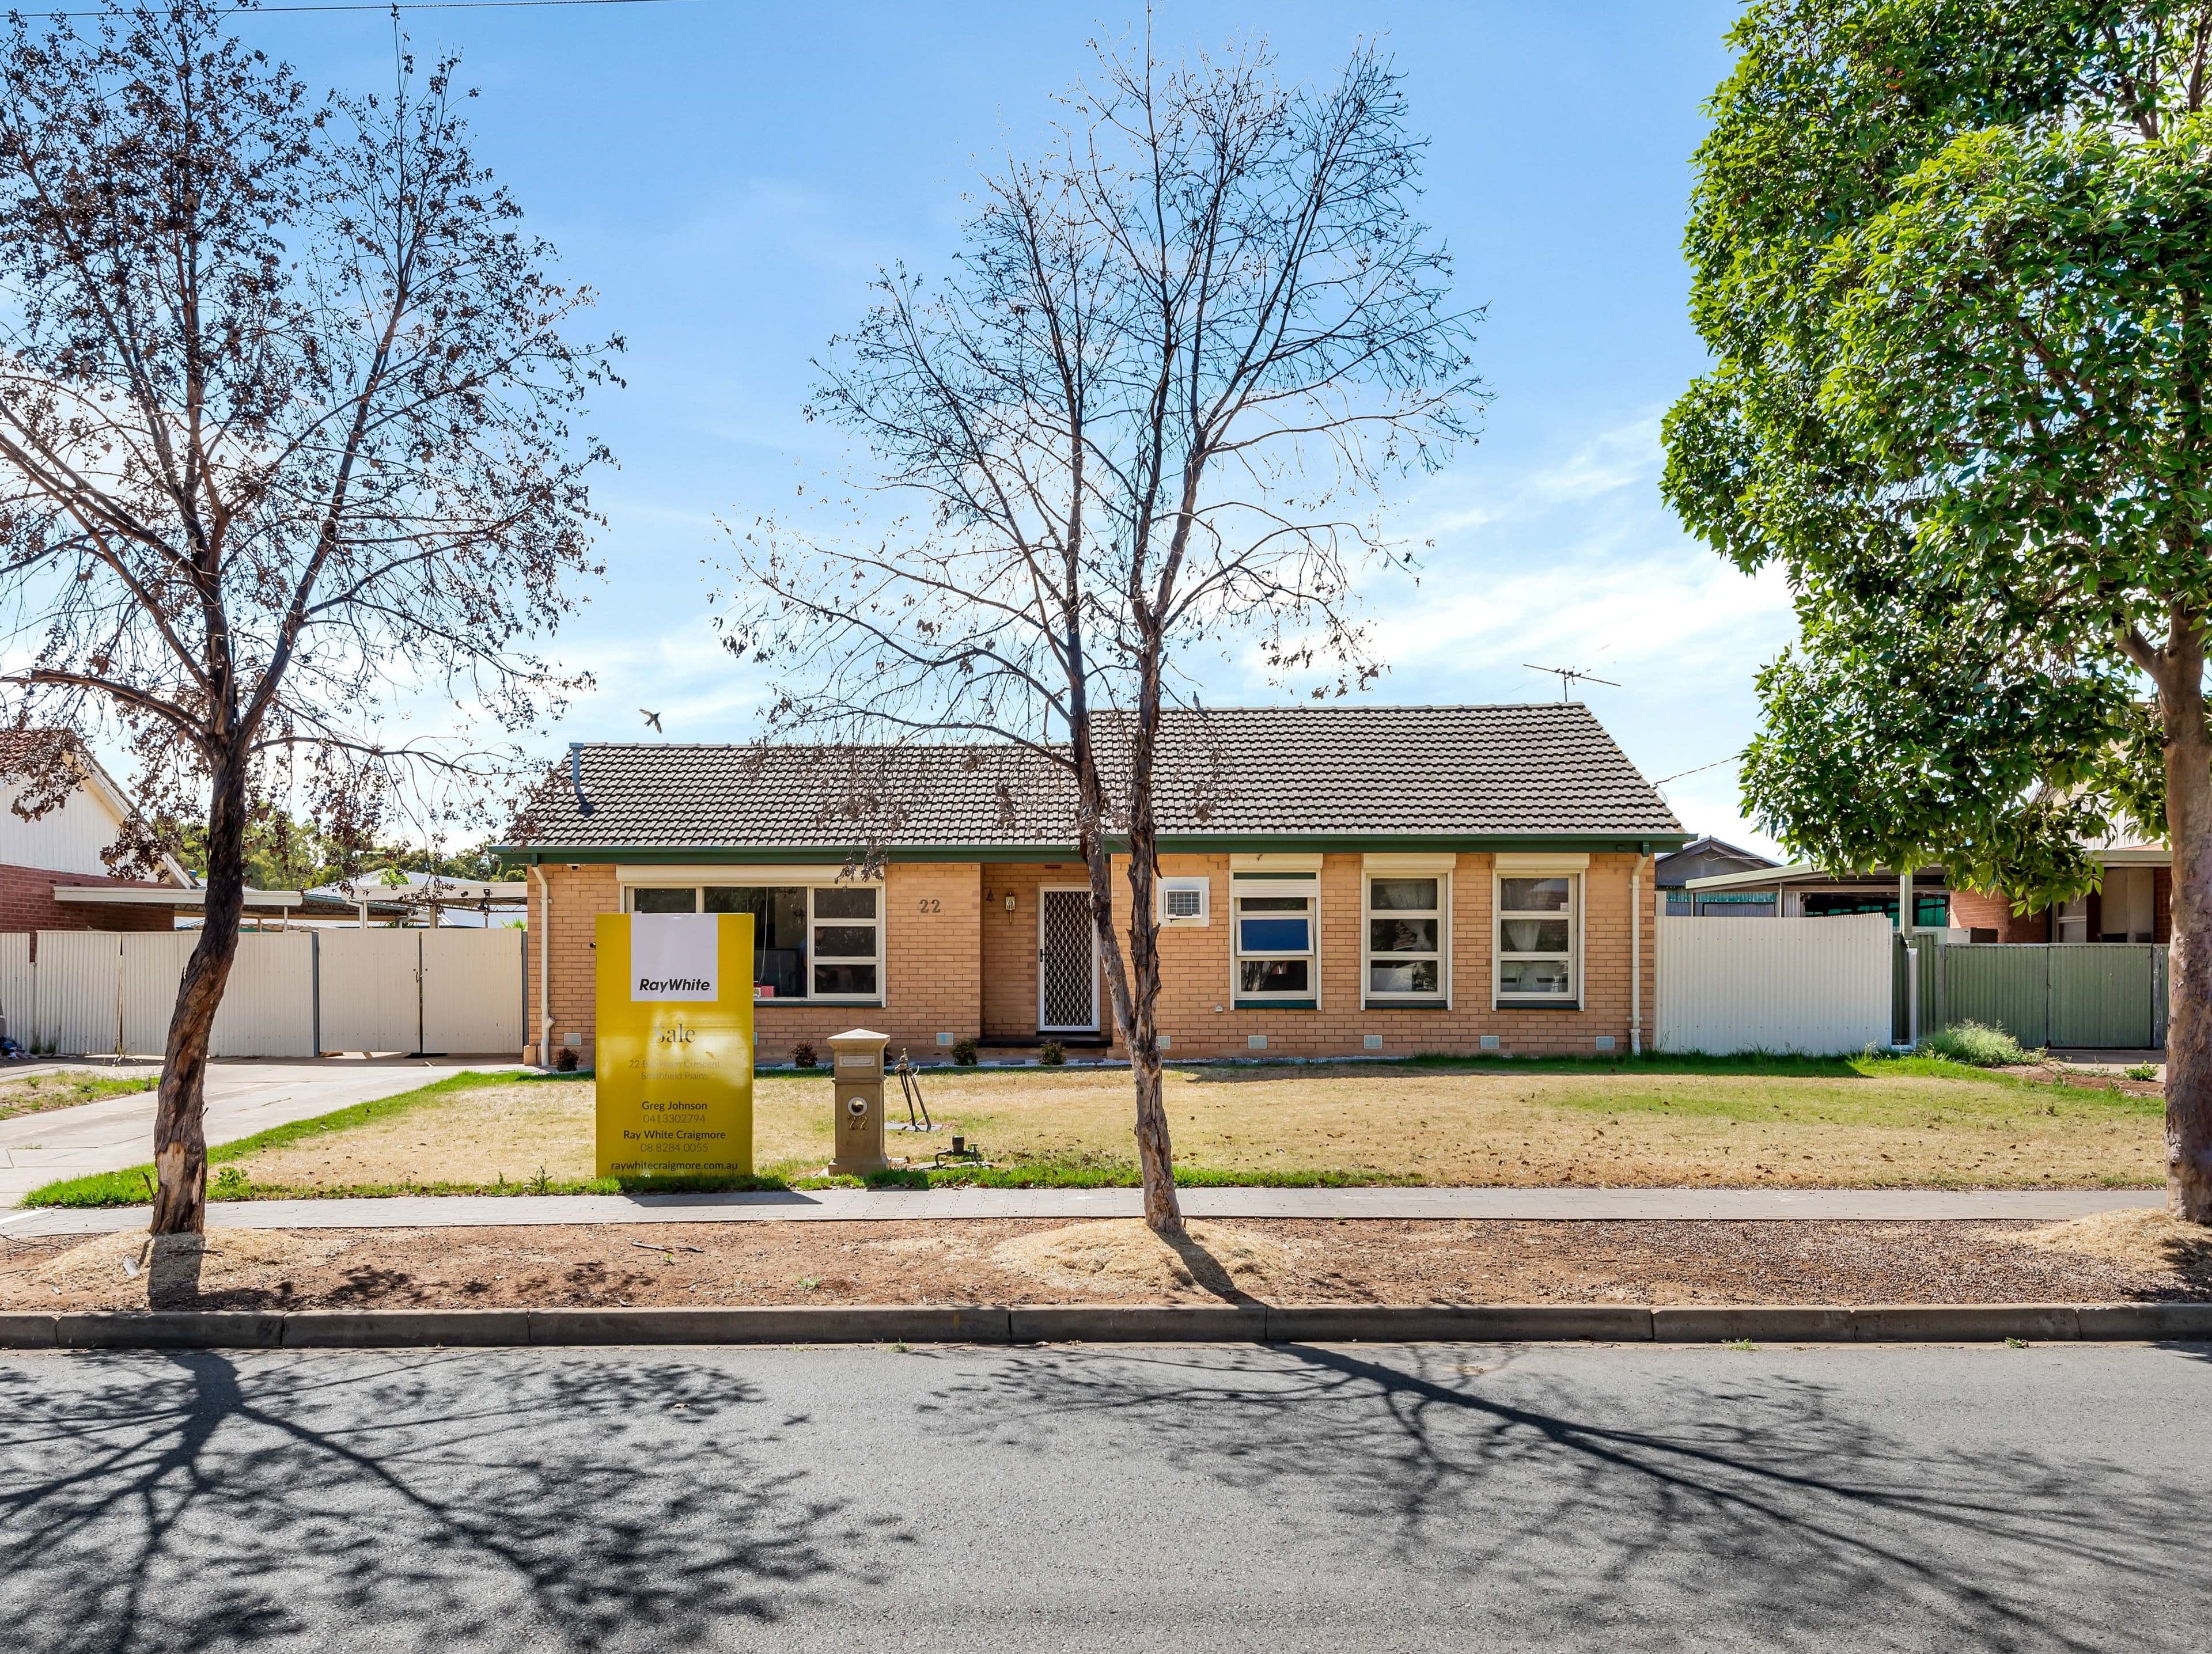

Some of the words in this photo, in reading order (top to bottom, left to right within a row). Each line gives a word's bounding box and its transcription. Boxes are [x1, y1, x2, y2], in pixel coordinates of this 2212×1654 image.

[919, 899, 941, 913] 22
[654, 1023, 696, 1043] Sale
[629, 1060, 639, 1068] 22
[685, 1072, 708, 1080] Plains
[642, 1101, 665, 1111] Greg
[668, 1101, 707, 1110] Johnson
[643, 1114, 705, 1123] 0413302794
[847, 1116, 868, 1130] 22
[623, 1131, 641, 1140] Ray
[644, 1130, 673, 1139] White
[676, 1130, 726, 1140] Craigmore
[641, 1143, 653, 1152] 08
[656, 1143, 680, 1152] 8284
[683, 1143, 708, 1152] 0055
[611, 1161, 738, 1171] raywhitecraigmore.com.au
